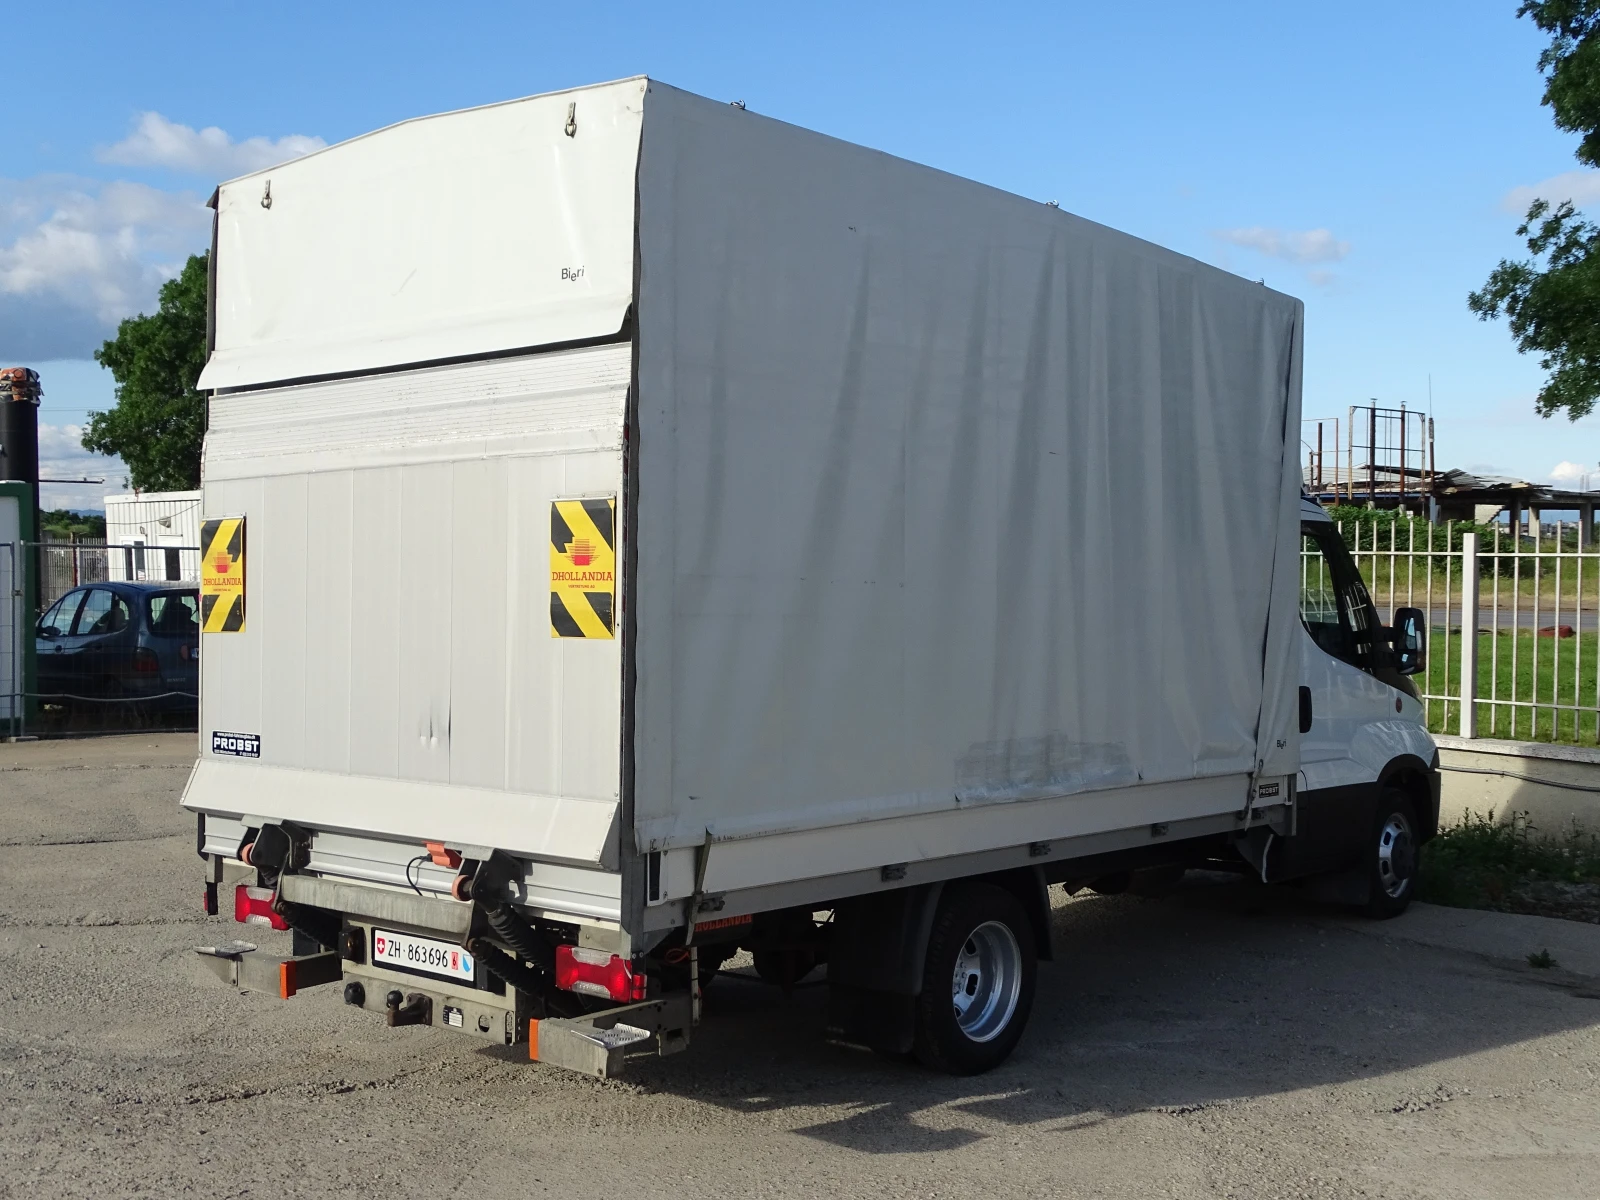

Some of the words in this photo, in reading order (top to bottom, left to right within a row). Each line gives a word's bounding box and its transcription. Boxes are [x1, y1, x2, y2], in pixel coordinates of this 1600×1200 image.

[561, 265, 585, 282] Bieri
[203, 577, 242, 586] DHOLLANDIA
[551, 571, 613, 581] DHOLLANDIA
[213, 737, 259, 752] PROBST
[1259, 786, 1279, 795] PROBST
[695, 913, 752, 932] HOLLANDIA
[407, 943, 449, 968] 863696
